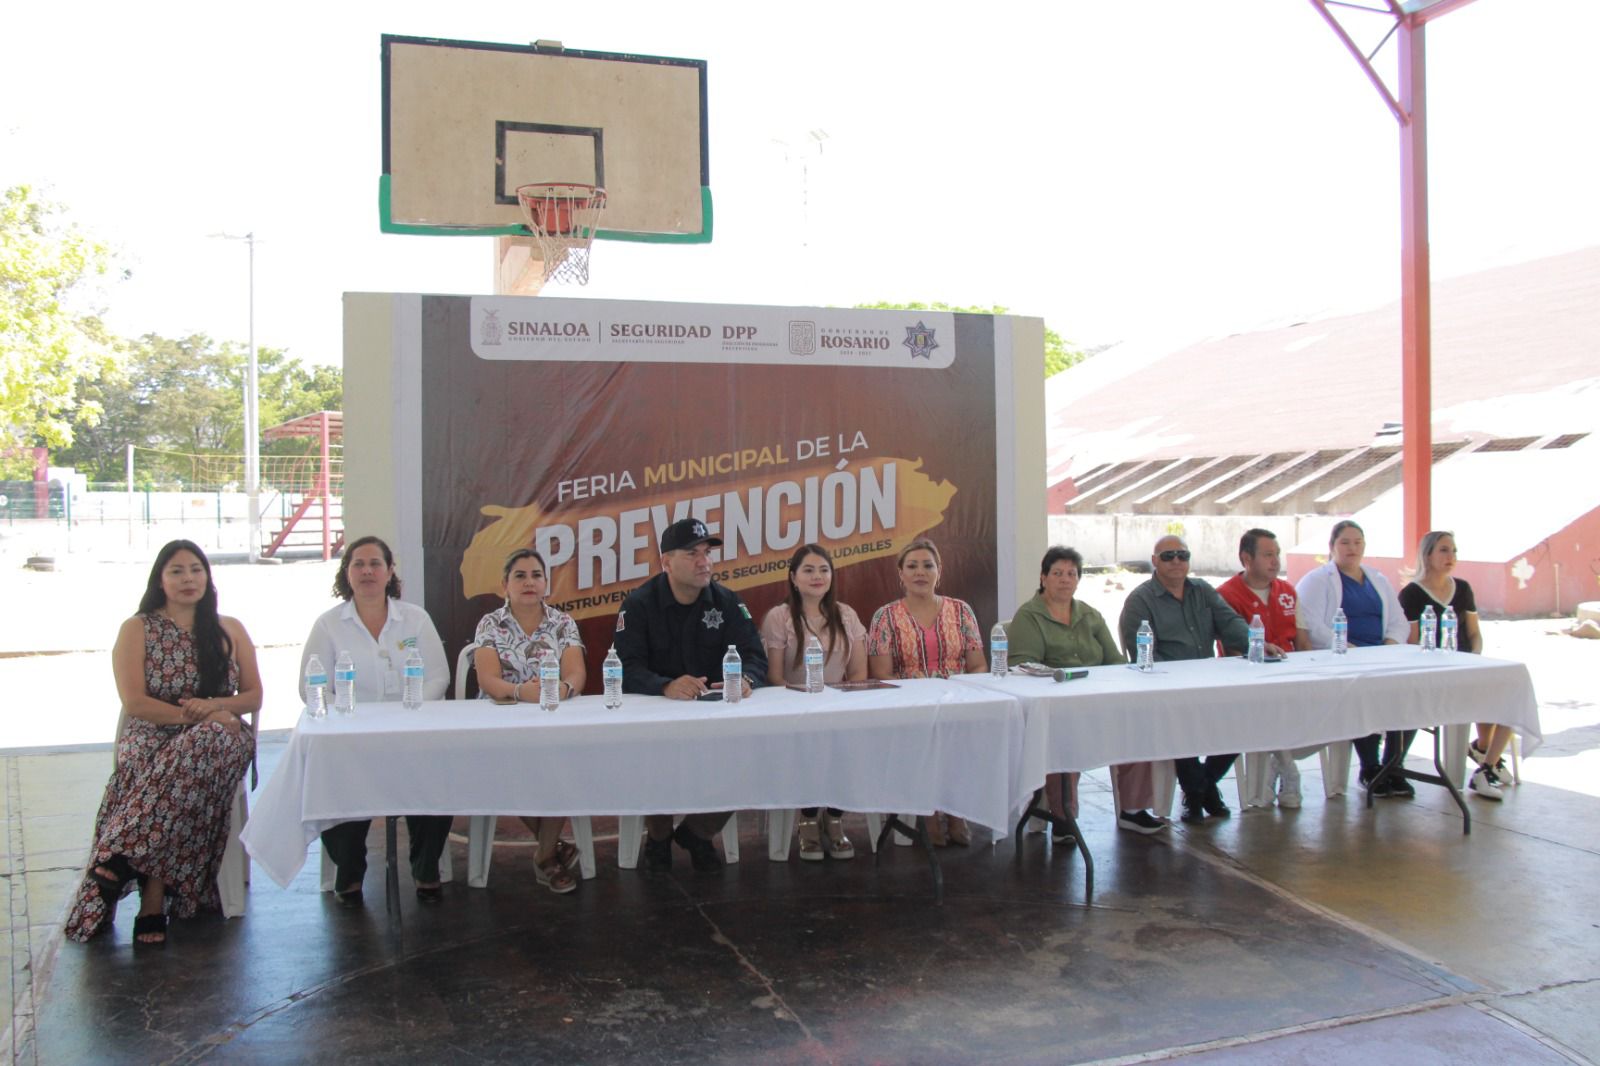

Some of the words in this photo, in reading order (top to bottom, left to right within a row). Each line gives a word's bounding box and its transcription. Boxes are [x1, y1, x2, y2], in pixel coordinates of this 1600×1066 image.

[508, 321, 590, 337] SINALOA
[610, 323, 712, 339] SEGURIDAD
[722, 325, 758, 340] DPP
[820, 335, 890, 350] ROSARIO
[557, 470, 637, 503] FERIA
[644, 444, 790, 488] MUNICIPAL
[796, 436, 830, 461] DE
[838, 430, 869, 453] LA
